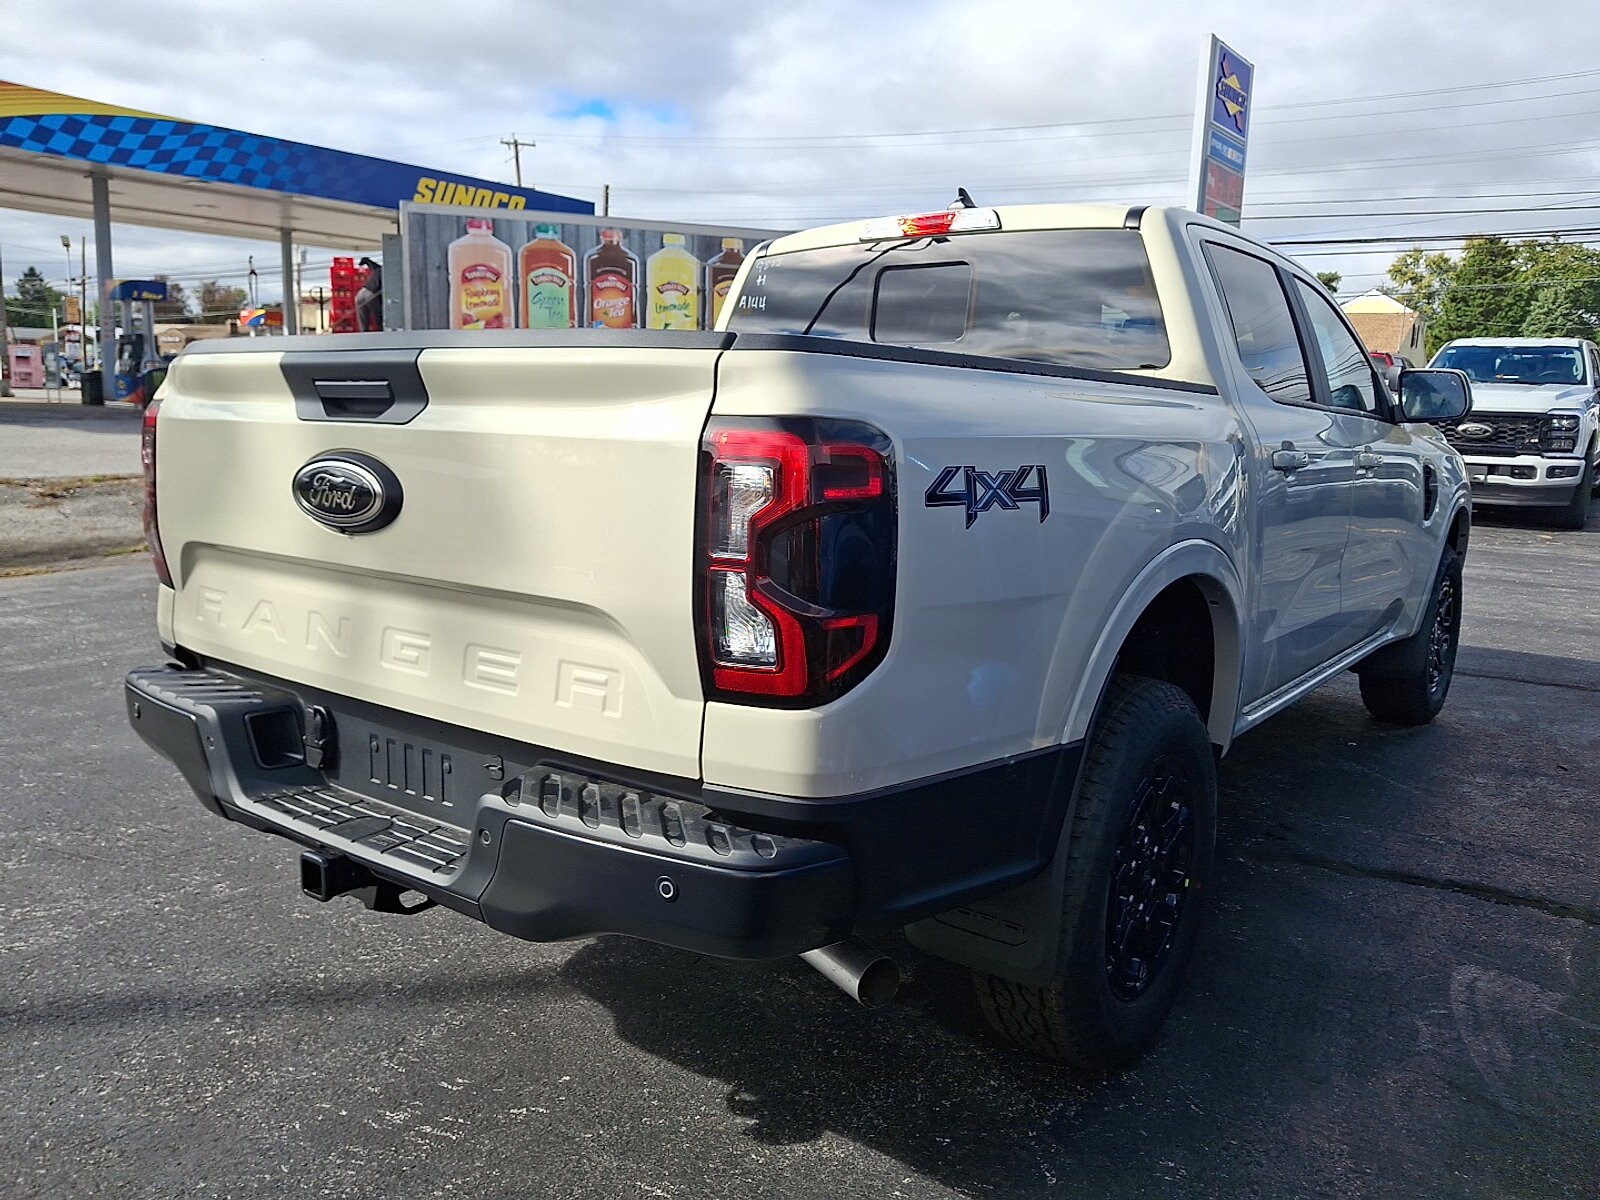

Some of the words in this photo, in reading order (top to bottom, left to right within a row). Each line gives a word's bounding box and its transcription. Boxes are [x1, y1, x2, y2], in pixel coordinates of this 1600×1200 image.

[756, 274, 767, 286] H
[594, 297, 630, 309] Orange
[656, 299, 690, 313] Lemonade
[739, 295, 767, 311] A144
[609, 308, 625, 318] Tea
[310, 473, 357, 510] Ford
[196, 584, 626, 720] RANGER
